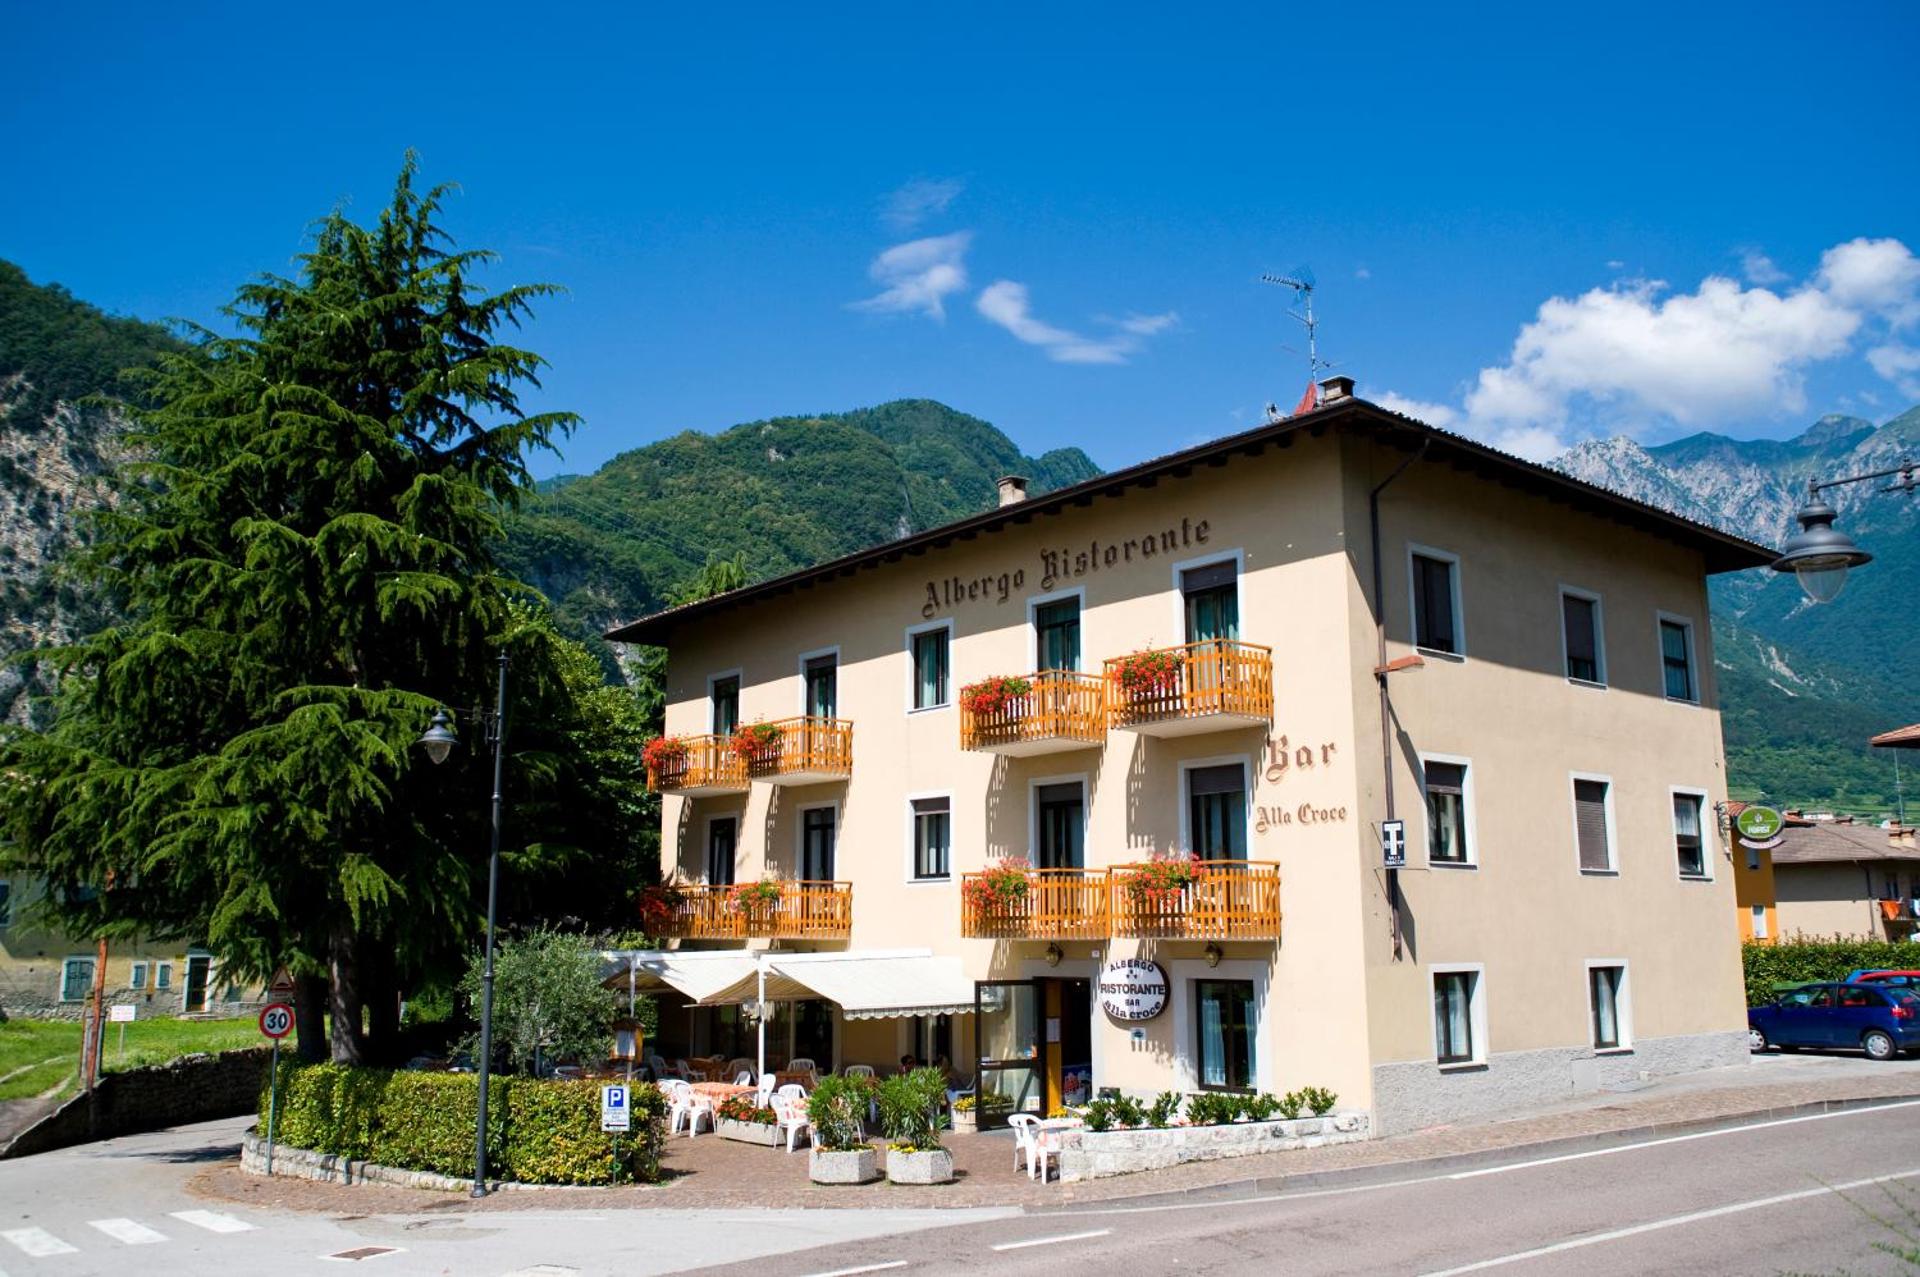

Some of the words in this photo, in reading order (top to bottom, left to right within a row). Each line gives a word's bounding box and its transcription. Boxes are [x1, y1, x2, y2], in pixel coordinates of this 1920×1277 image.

[922, 568, 1025, 618] Albergo
[1040, 517, 1211, 591] Ristorante
[1266, 734, 1336, 783] Bar
[1256, 806, 1293, 834] Alla
[1297, 802, 1347, 825] Croce
[1110, 959, 1155, 973] ALBERGO
[1100, 983, 1166, 995] RISTORANTE
[1104, 1000, 1127, 1018] alla
[1129, 1001, 1161, 1019] croce
[1125, 998, 1140, 1007] BAR
[267, 1012, 288, 1029] 30
[610, 1090, 622, 1106] P
